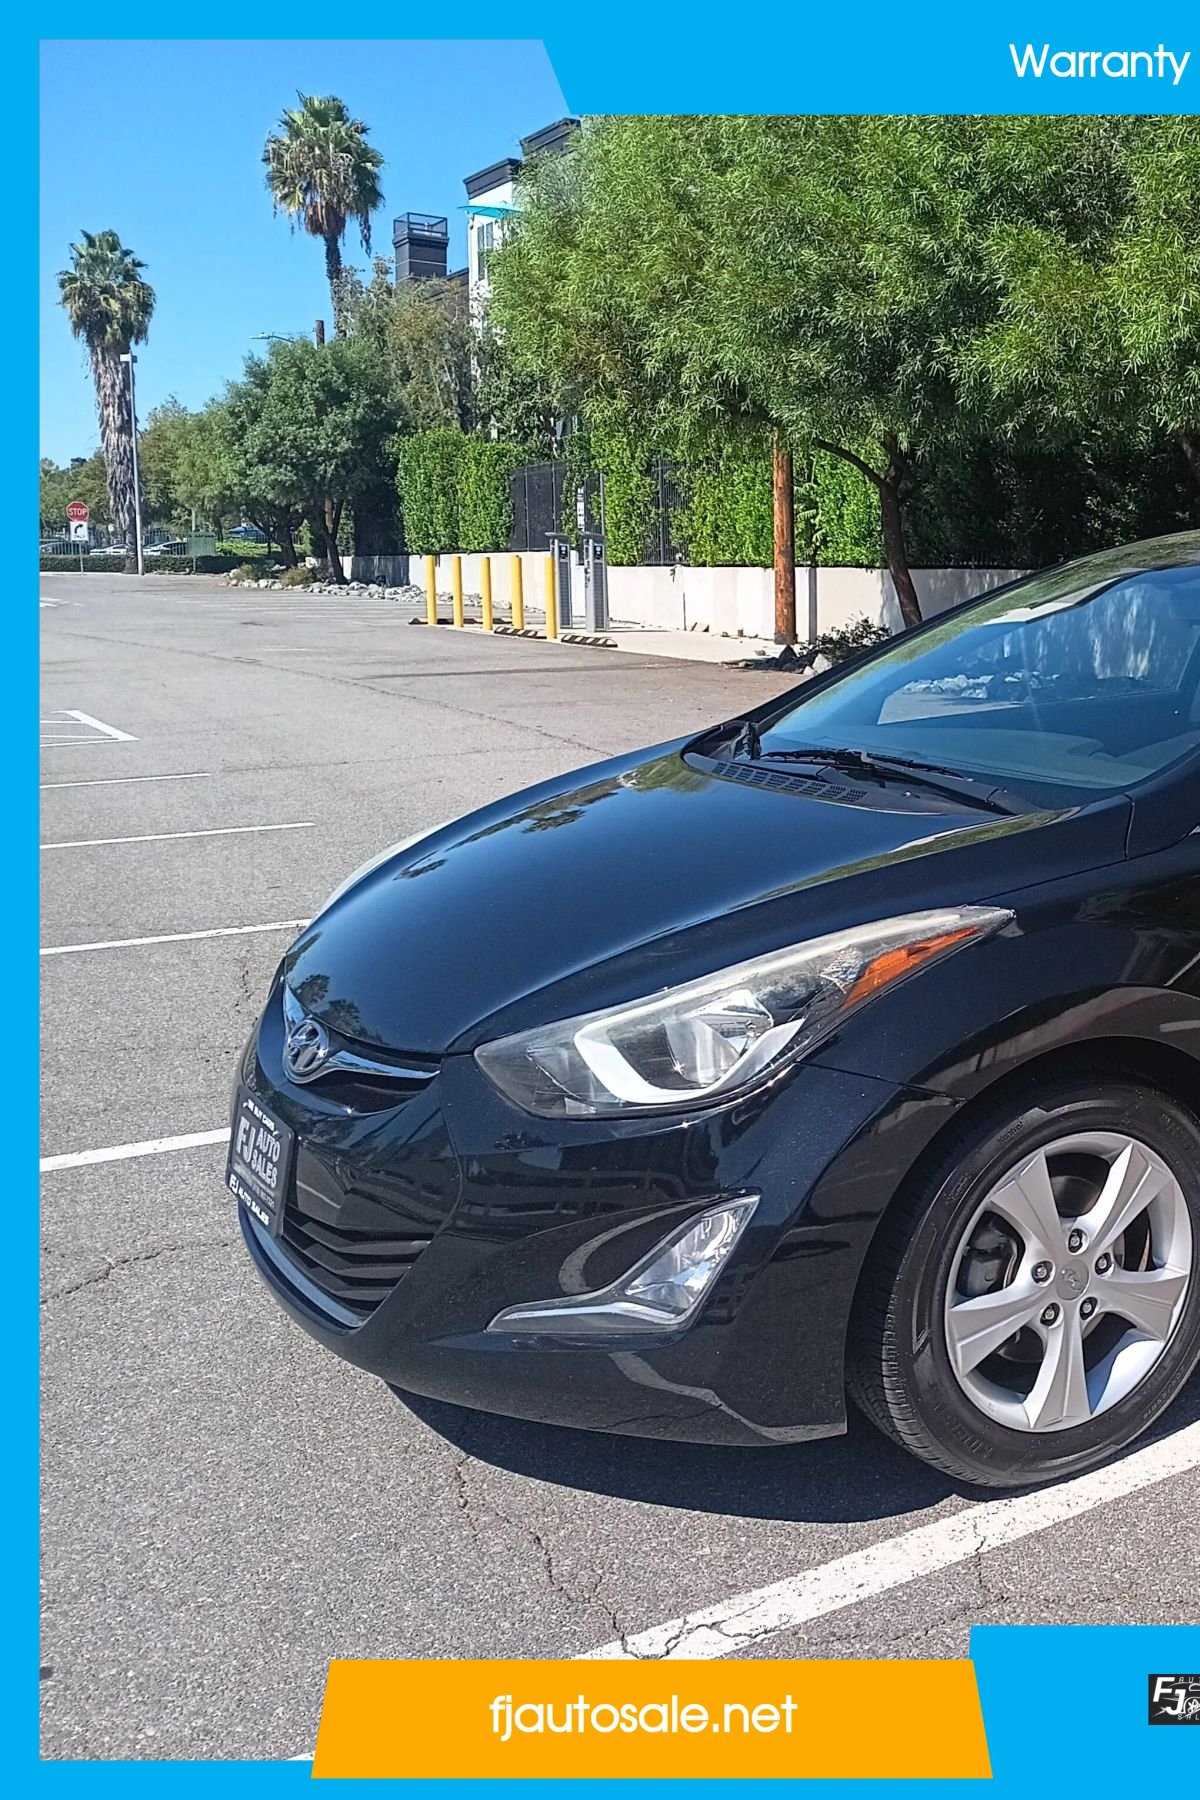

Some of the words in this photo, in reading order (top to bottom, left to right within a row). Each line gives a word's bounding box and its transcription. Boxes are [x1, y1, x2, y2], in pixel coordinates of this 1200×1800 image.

[68, 508, 87, 516] STOP
[236, 1116, 256, 1164] FJ
[256, 1127, 281, 1162] AUTO
[251, 1150, 278, 1189] SALES
[238, 1187, 252, 1207] AUTO
[251, 1200, 269, 1226] SALES
